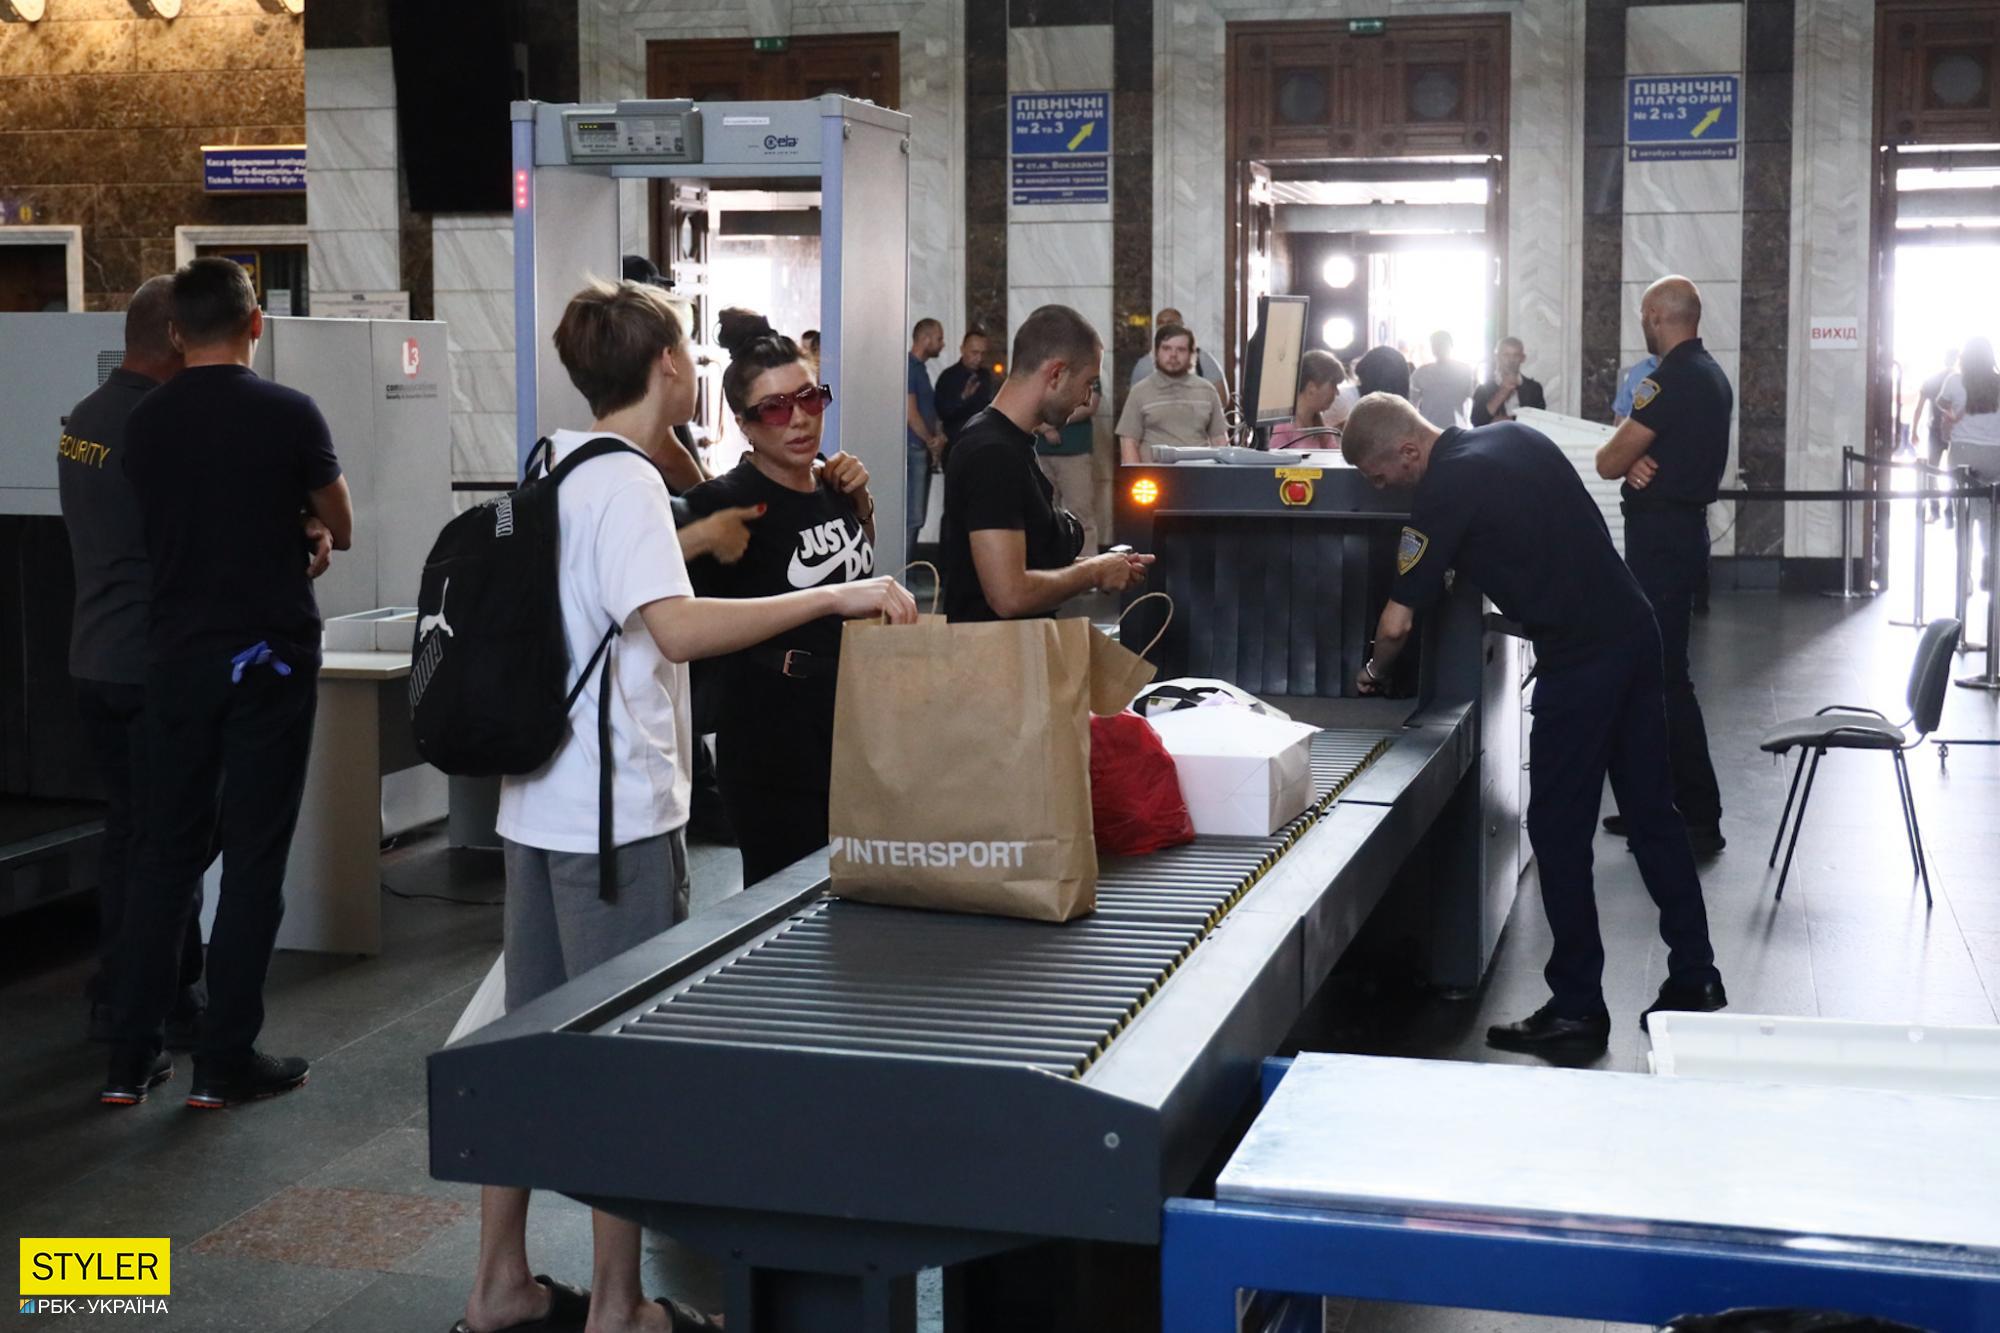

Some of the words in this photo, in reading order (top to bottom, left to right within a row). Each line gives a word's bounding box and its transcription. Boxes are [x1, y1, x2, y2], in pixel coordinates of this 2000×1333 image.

[1635, 80, 1732, 95] ПІВНІЧНІ
[1016, 97, 1104, 111] ПІВНІЧНІ
[1634, 94, 1732, 105] ПЛАТФОРМИ
[1016, 110, 1104, 120] ПЛАТФОРМИ
[1650, 107, 1660, 120] 2
[1677, 106, 1687, 119] 3
[1030, 122, 1040, 134] 2
[1055, 121, 1064, 134] 3
[1052, 160, 1106, 169] Вокзальна
[233, 176, 244, 184] for
[266, 176, 280, 186] City
[1812, 327, 1857, 341] ВИХІД
[799, 518, 850, 560] JUST
[844, 541, 874, 583] DO
[845, 836, 1027, 868] INTERSPORT
